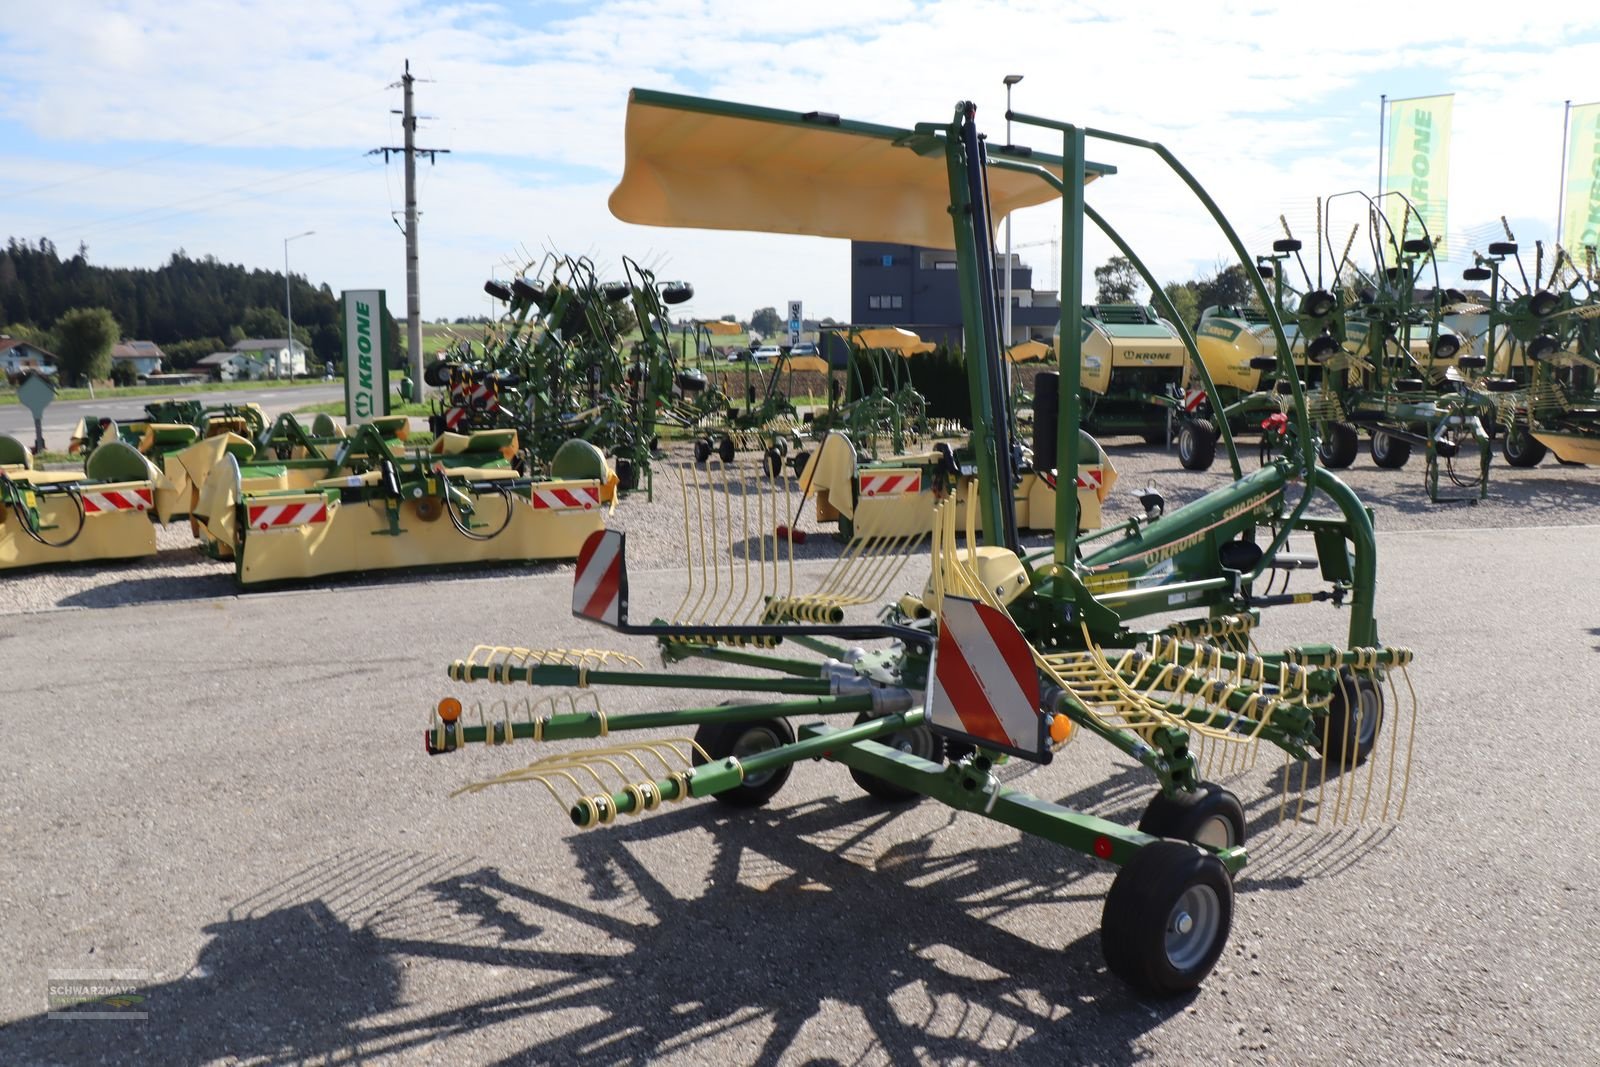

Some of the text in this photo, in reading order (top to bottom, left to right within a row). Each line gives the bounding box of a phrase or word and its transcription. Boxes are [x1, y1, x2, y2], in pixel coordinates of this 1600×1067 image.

[356, 301, 373, 390] KRONE
[1135, 352, 1171, 360] KRONE
[1160, 532, 1205, 560] KRONE
